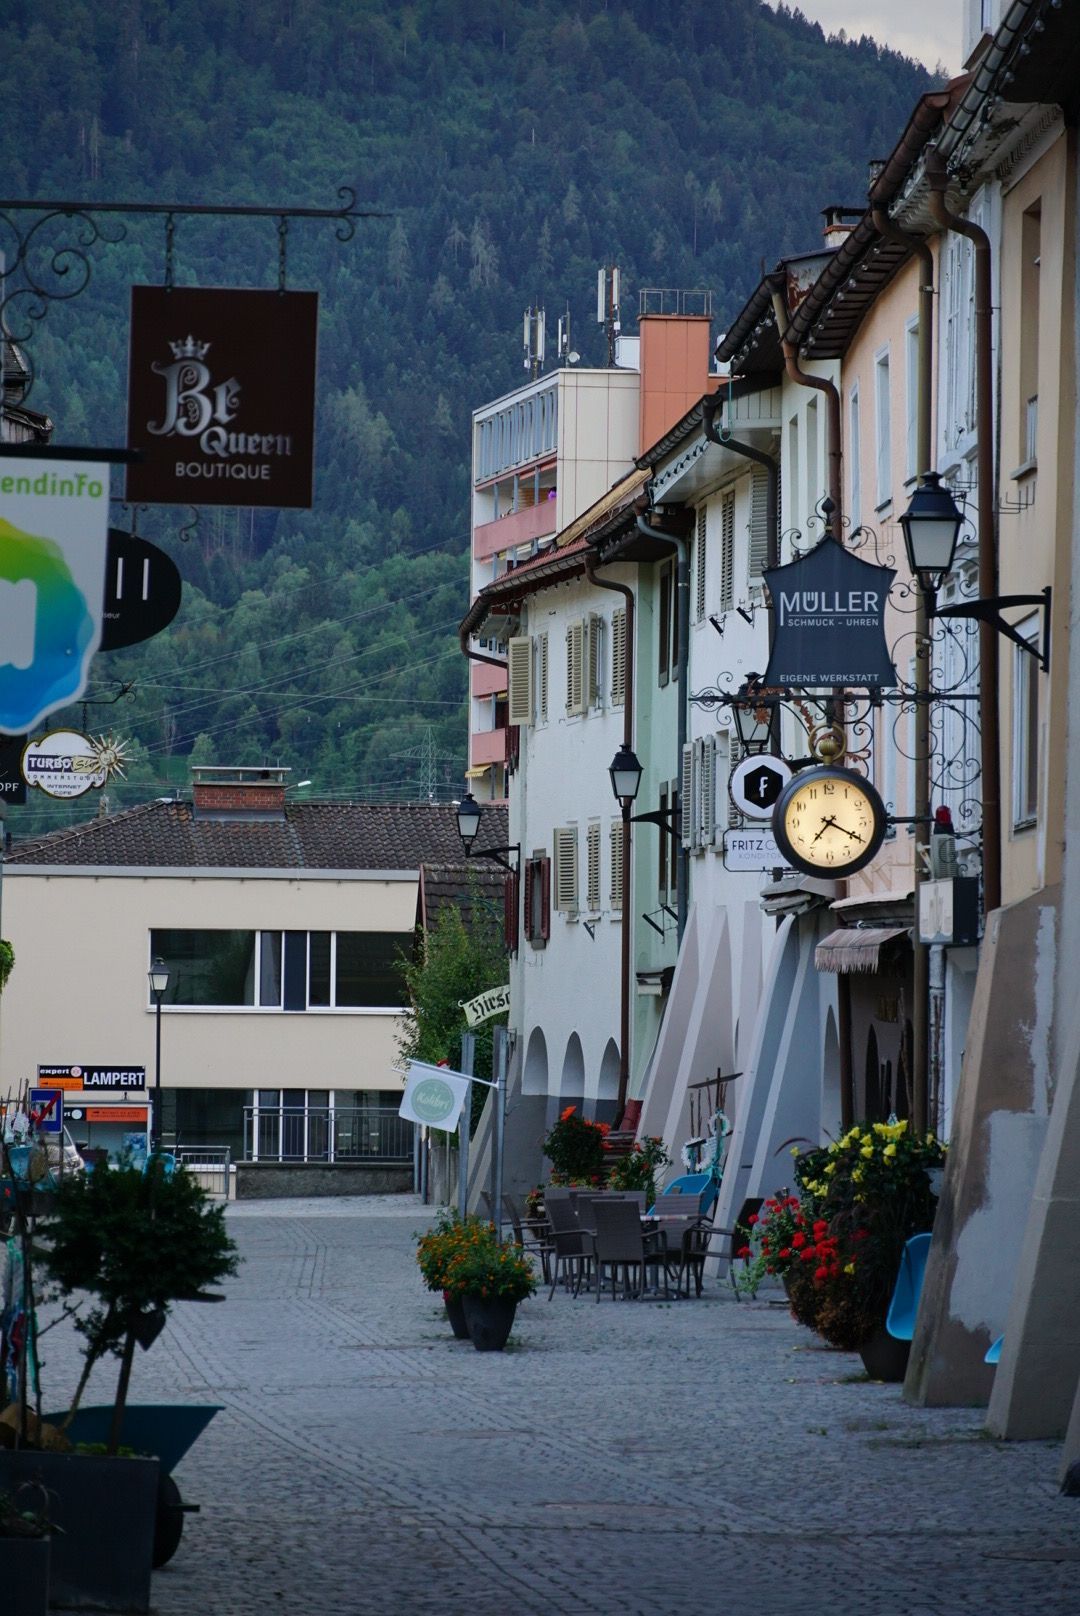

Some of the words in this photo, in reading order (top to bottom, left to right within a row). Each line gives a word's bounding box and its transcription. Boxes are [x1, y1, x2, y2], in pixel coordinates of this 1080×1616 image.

[147, 360, 242, 437] Be
[200, 426, 292, 458] Queen
[175, 462, 271, 480] BOUTIQUE
[780, 591, 879, 620] MÜLLER
[788, 618, 835, 627] SCHMUCK
[846, 618, 879, 627] UHREN
[780, 674, 817, 683] EIGENE
[820, 673, 879, 683] WERKSTATT
[28, 757, 72, 771] TURBO
[732, 839, 763, 851] FRITZ
[39, 1068, 70, 1076] expert
[83, 1072, 145, 1086] LAMPERT
